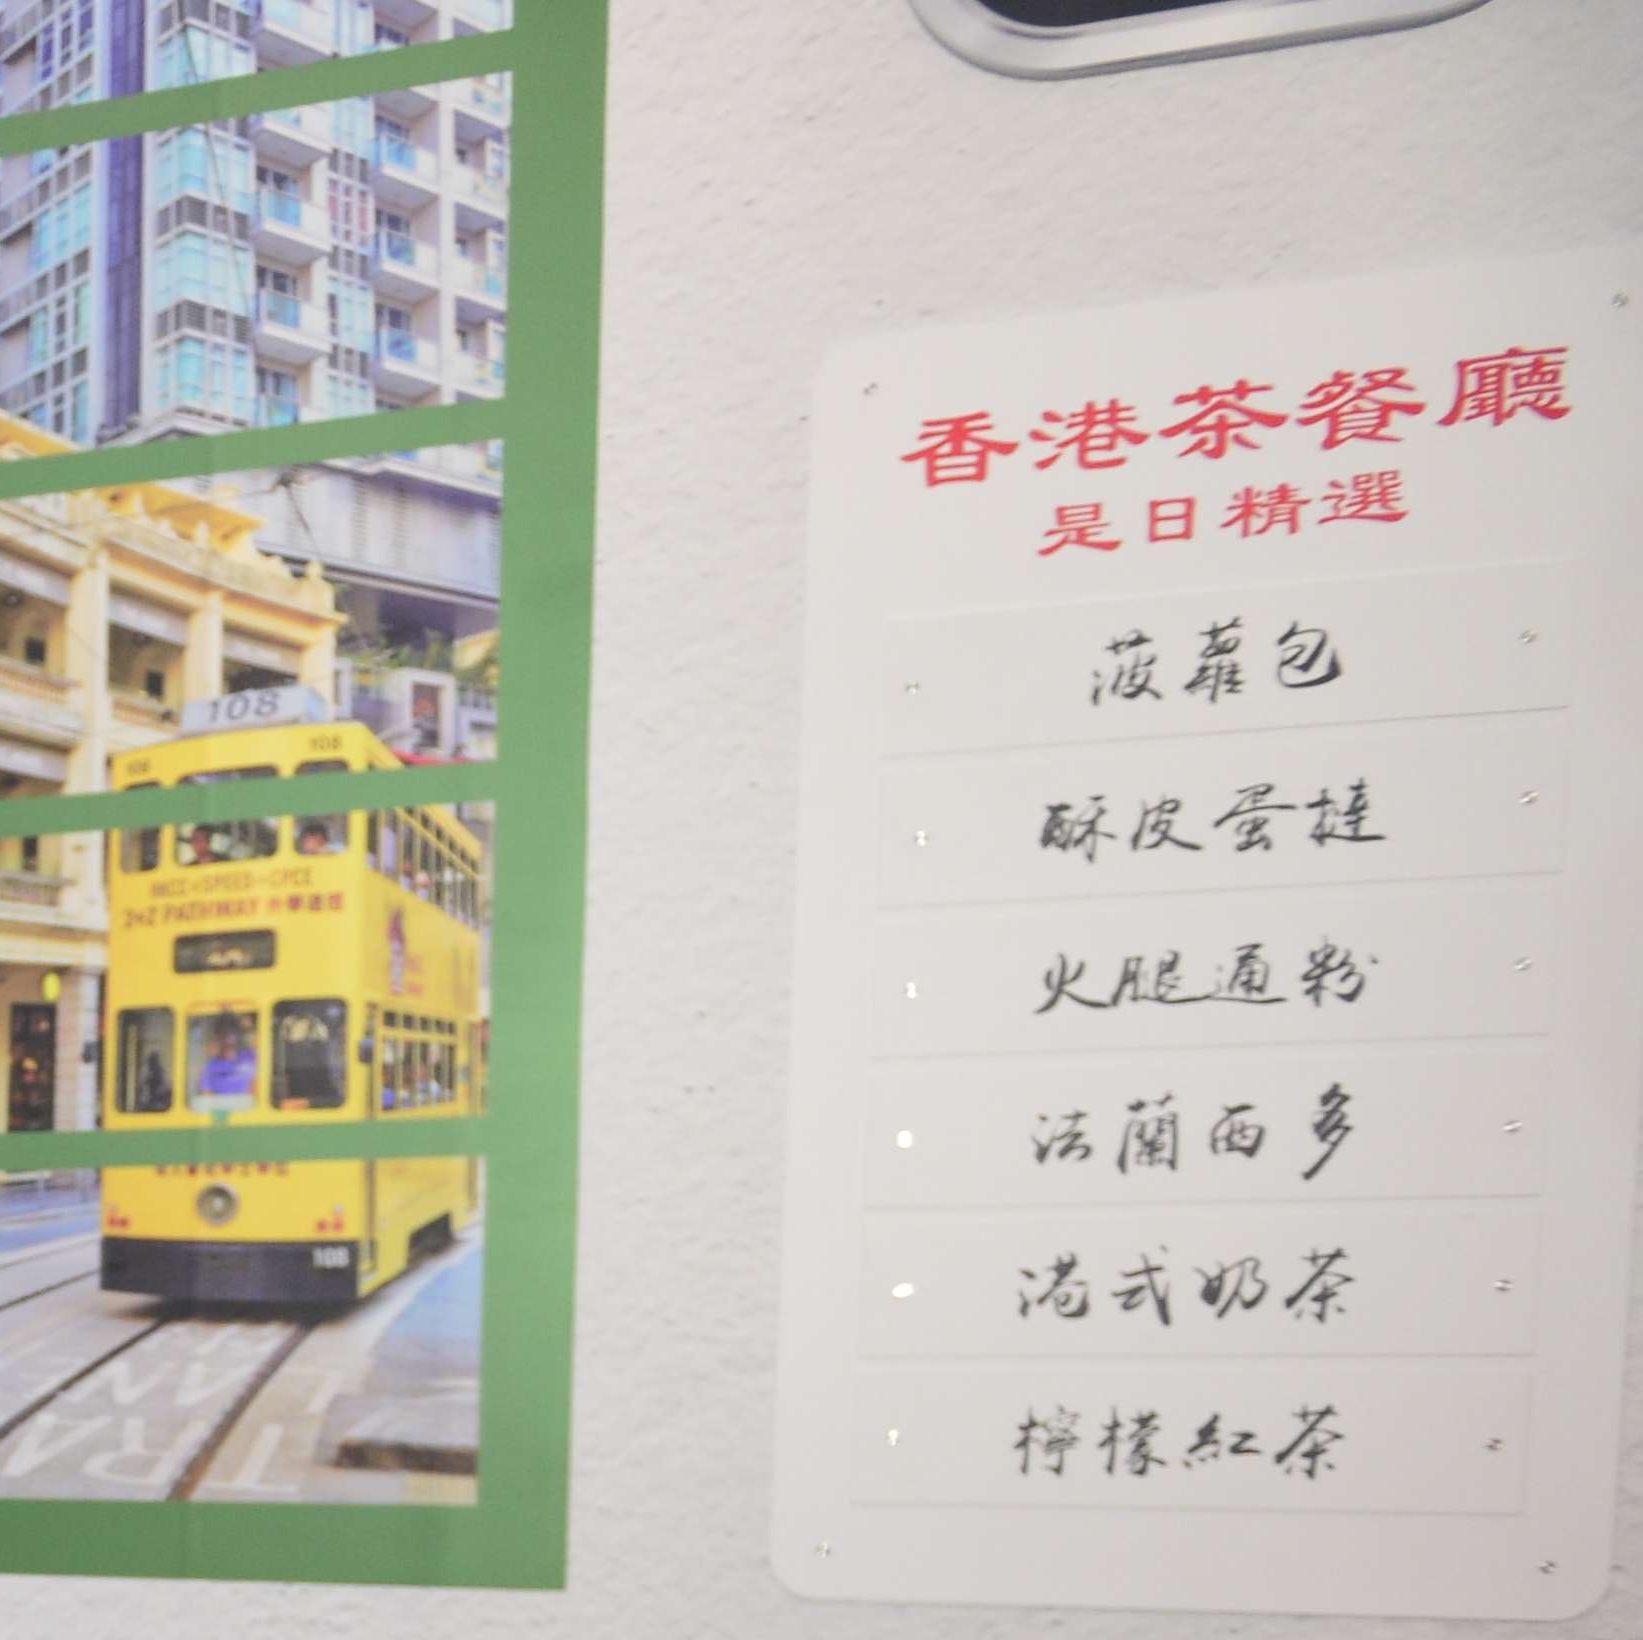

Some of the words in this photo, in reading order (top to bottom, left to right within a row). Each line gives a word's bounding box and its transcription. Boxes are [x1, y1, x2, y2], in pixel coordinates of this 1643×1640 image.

[901, 345, 1575, 488] 香港茶餐廳
[1036, 470, 1409, 557] 是日精選
[1091, 616, 1342, 706] 菠蘿包
[209, 689, 281, 723] 108
[1039, 778, 1388, 865] 酥皮蛋撻
[1033, 936, 1380, 1013] 火腿通粉
[1032, 1082, 1355, 1181] 法蘭西多
[1017, 1245, 1356, 1327] 港式奶茶
[1013, 1405, 1345, 1479] 檸檬紅茶
